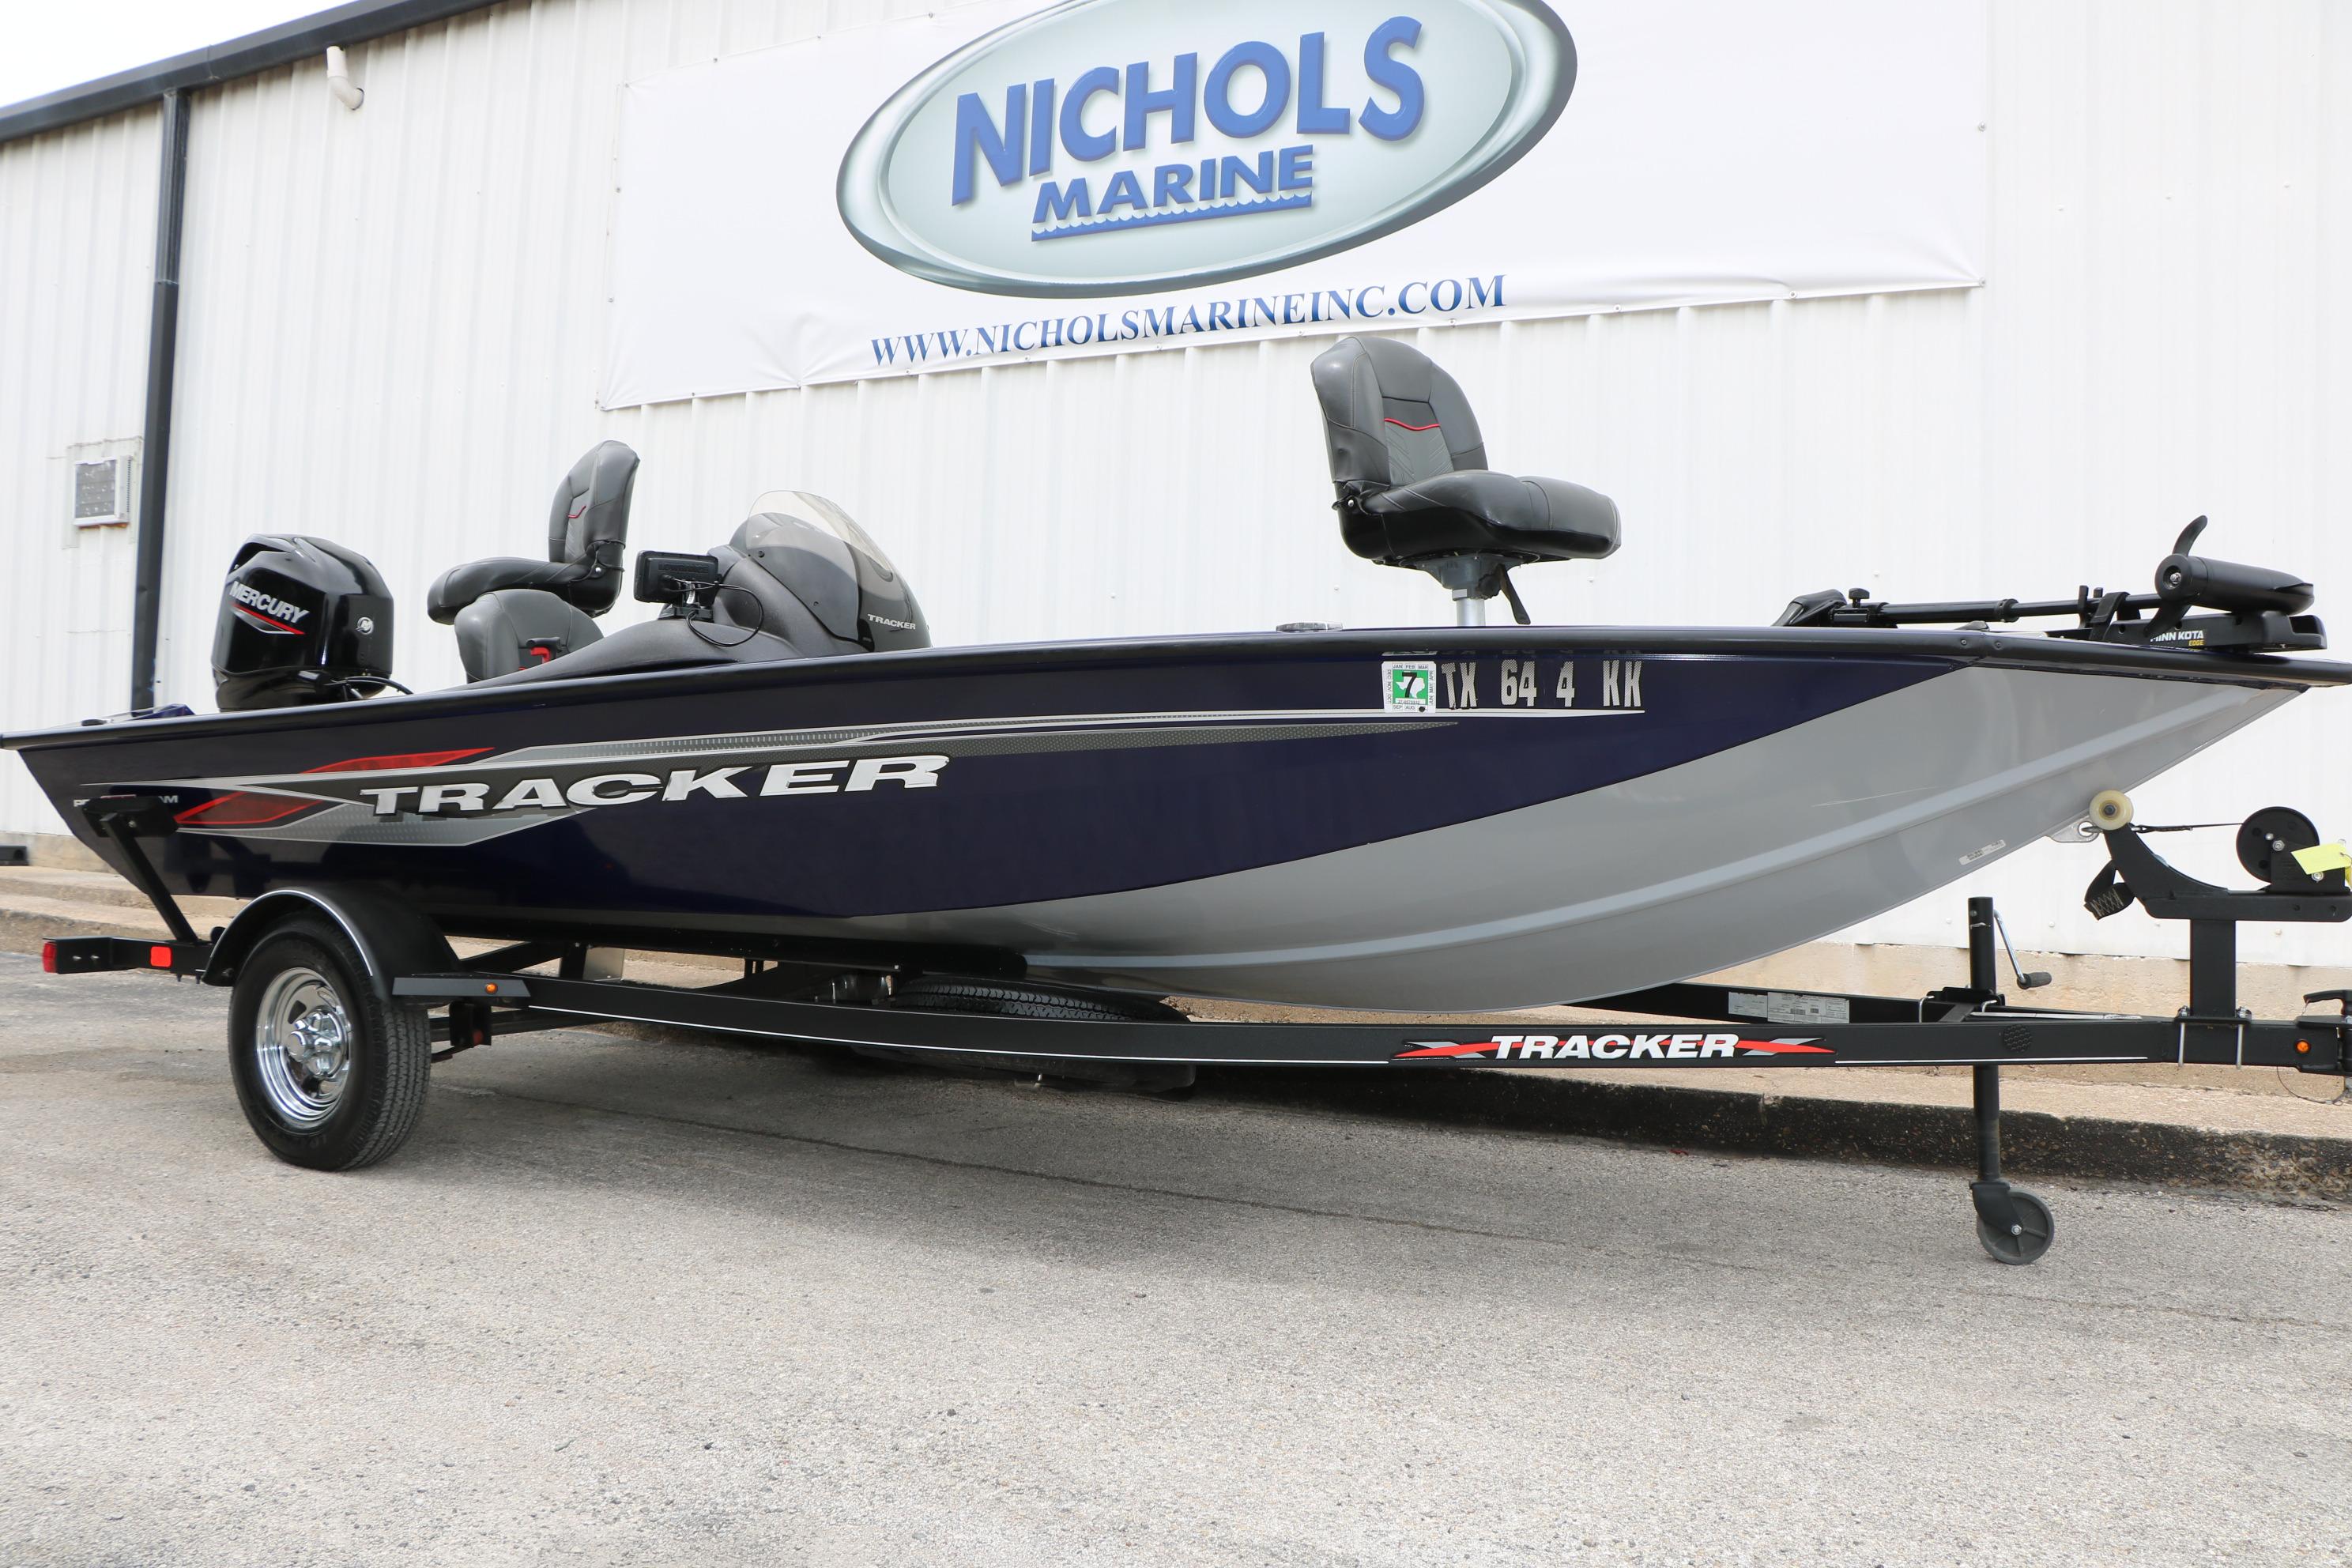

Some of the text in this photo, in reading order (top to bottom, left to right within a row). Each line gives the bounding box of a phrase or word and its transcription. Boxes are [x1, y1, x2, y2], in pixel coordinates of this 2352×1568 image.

[951, 15, 1427, 208] NICHOLS
[1031, 144, 1314, 225] MARINE
[870, 273, 1508, 367] WWW.NICHOLSMARINEINC.COM
[229, 580, 310, 624] MERCURY
[867, 613, 917, 630] TRACKER
[2178, 630, 2204, 640] KOTA
[1401, 672, 1418, 698] 7
[1442, 662, 1478, 710] TX
[1603, 659, 1642, 707] KK
[360, 755, 950, 815] TRACKER
[1491, 1033, 1740, 1060] TRACKER
